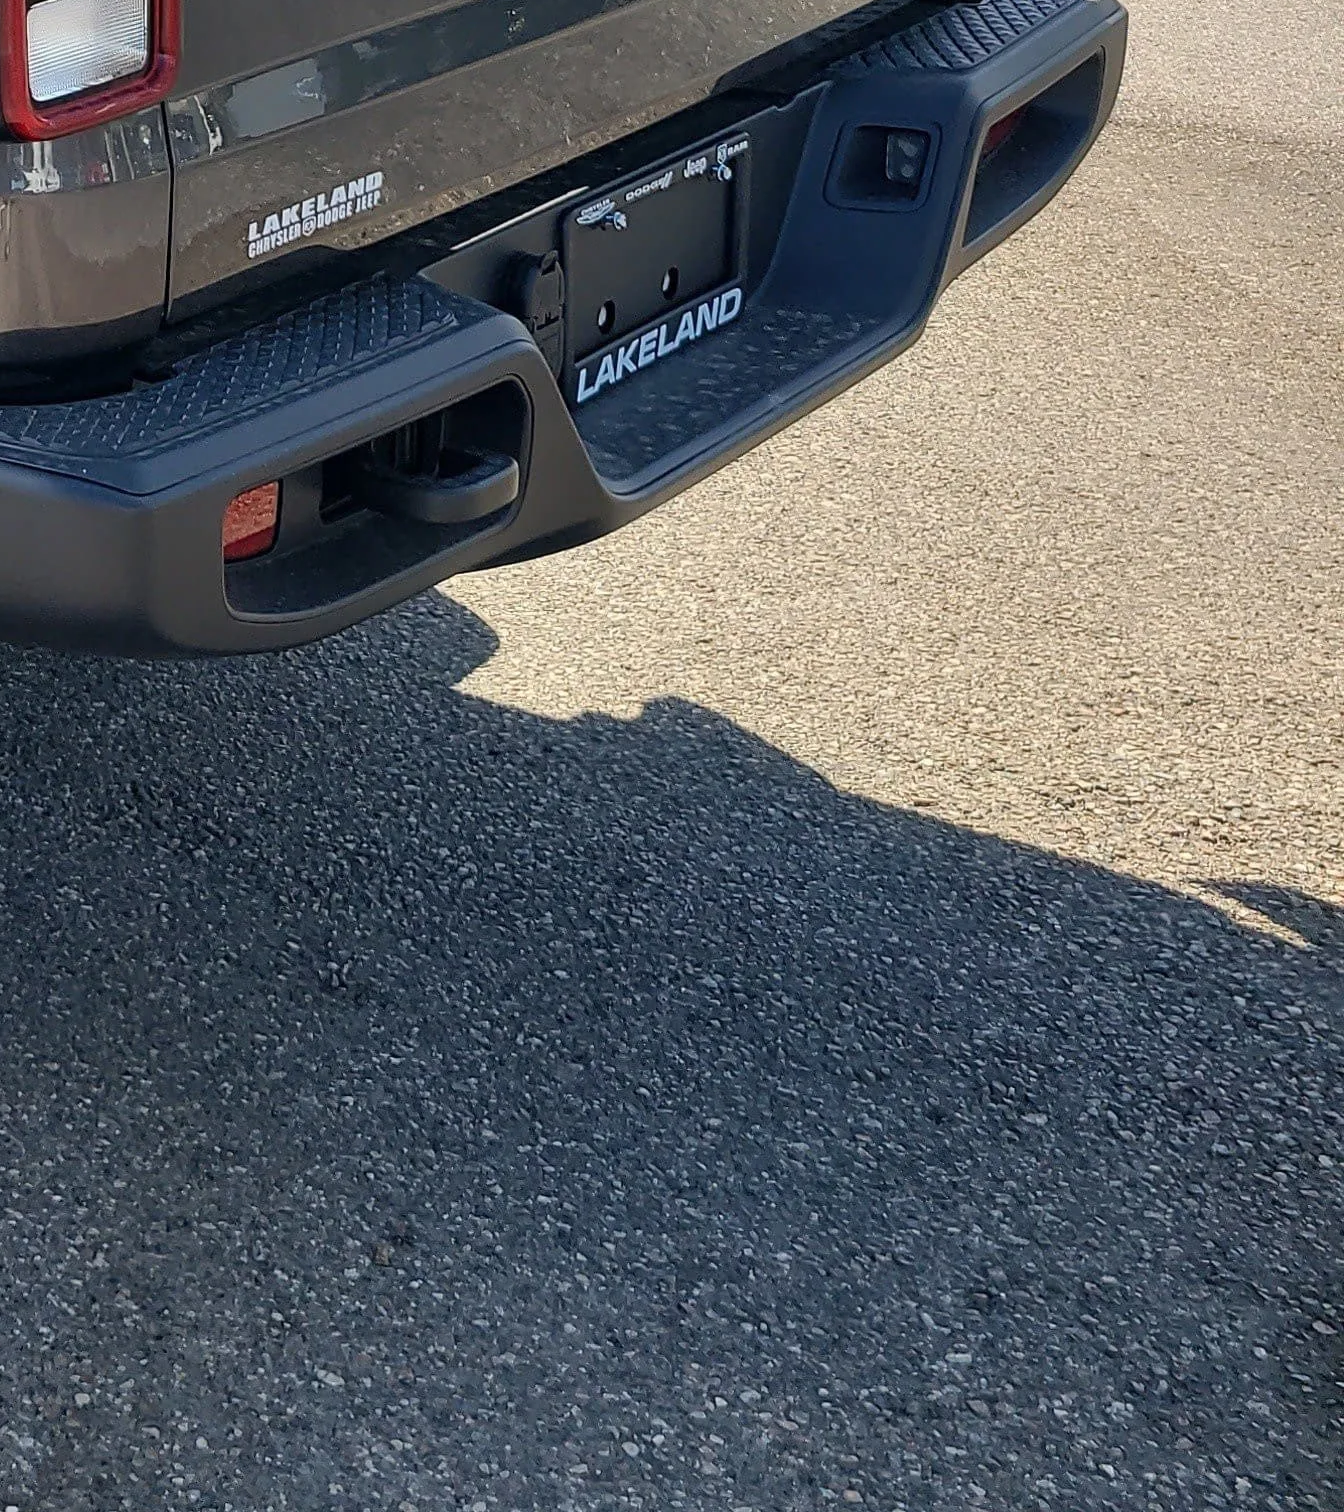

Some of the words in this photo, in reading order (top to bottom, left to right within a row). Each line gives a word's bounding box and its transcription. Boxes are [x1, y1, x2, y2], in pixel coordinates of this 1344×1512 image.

[625, 177, 665, 202] DODGE
[683, 157, 707, 179] Jeep
[727, 140, 749, 156] RAM
[248, 171, 384, 242] LAKELAND
[248, 222, 302, 259] CHRYSLER
[317, 201, 353, 229] DODGE
[355, 190, 381, 214] JEEP
[577, 287, 742, 403] LAKELAND
